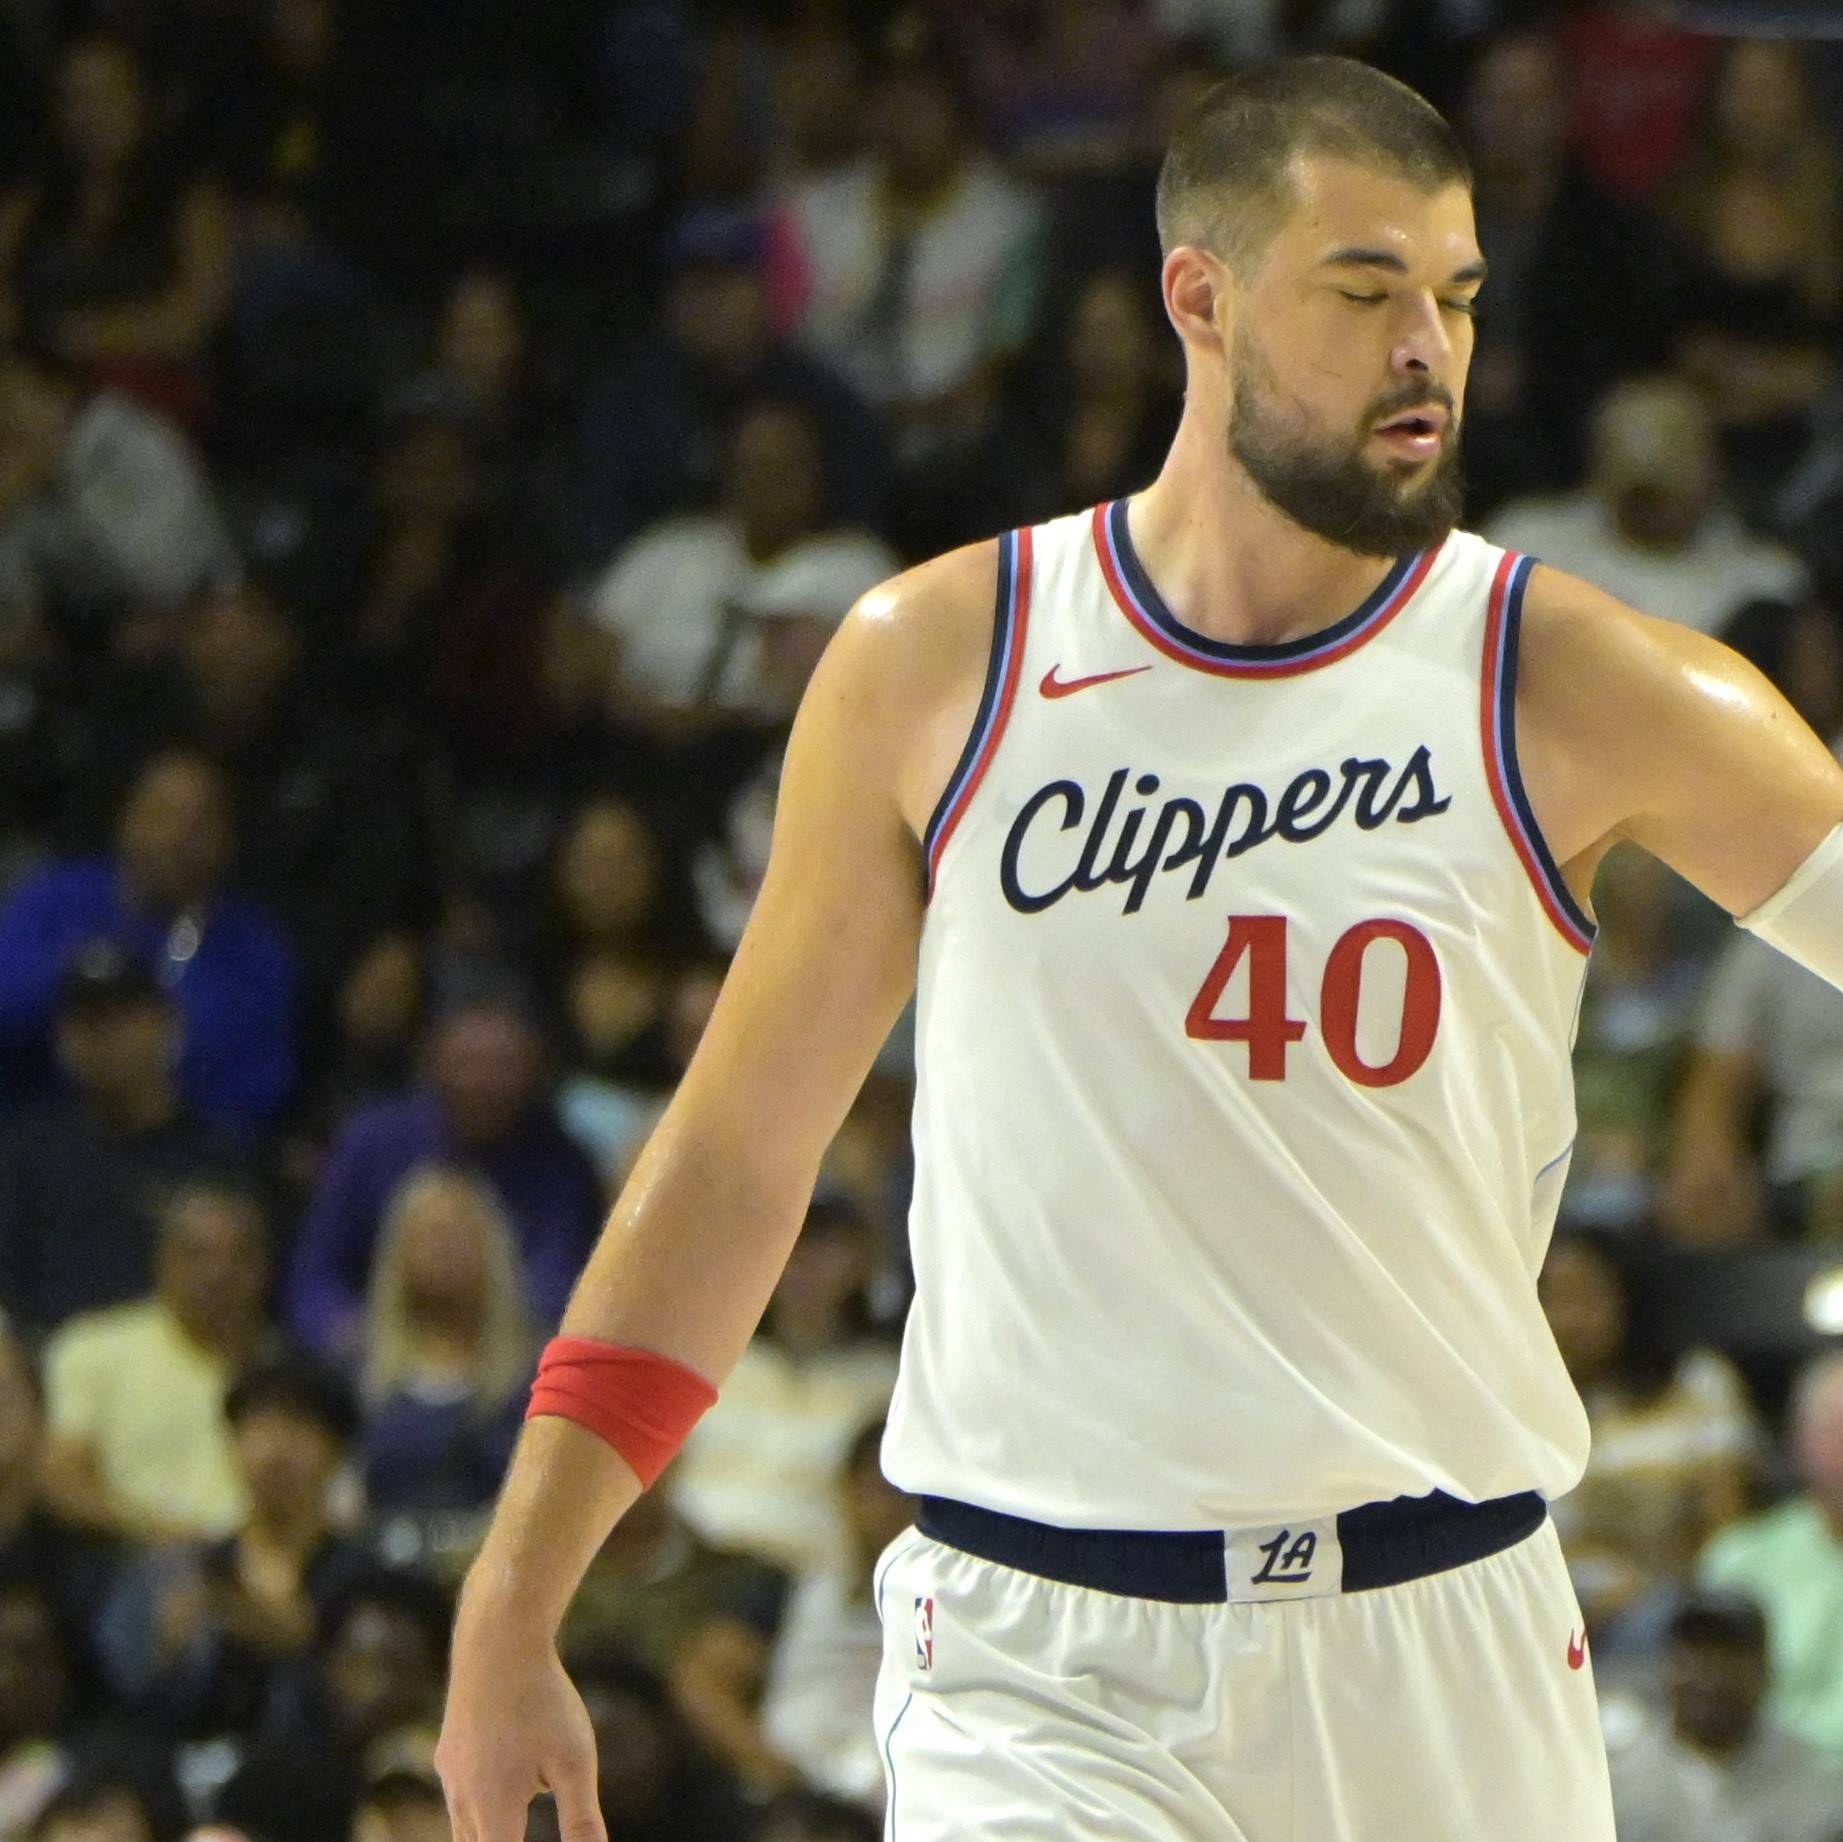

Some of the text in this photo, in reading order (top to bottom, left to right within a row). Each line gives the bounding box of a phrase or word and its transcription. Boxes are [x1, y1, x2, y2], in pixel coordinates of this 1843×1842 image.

[1000, 744, 1452, 915] Clippers
[1185, 915, 1442, 1088] 40
[1250, 1529, 1317, 1585] LA
